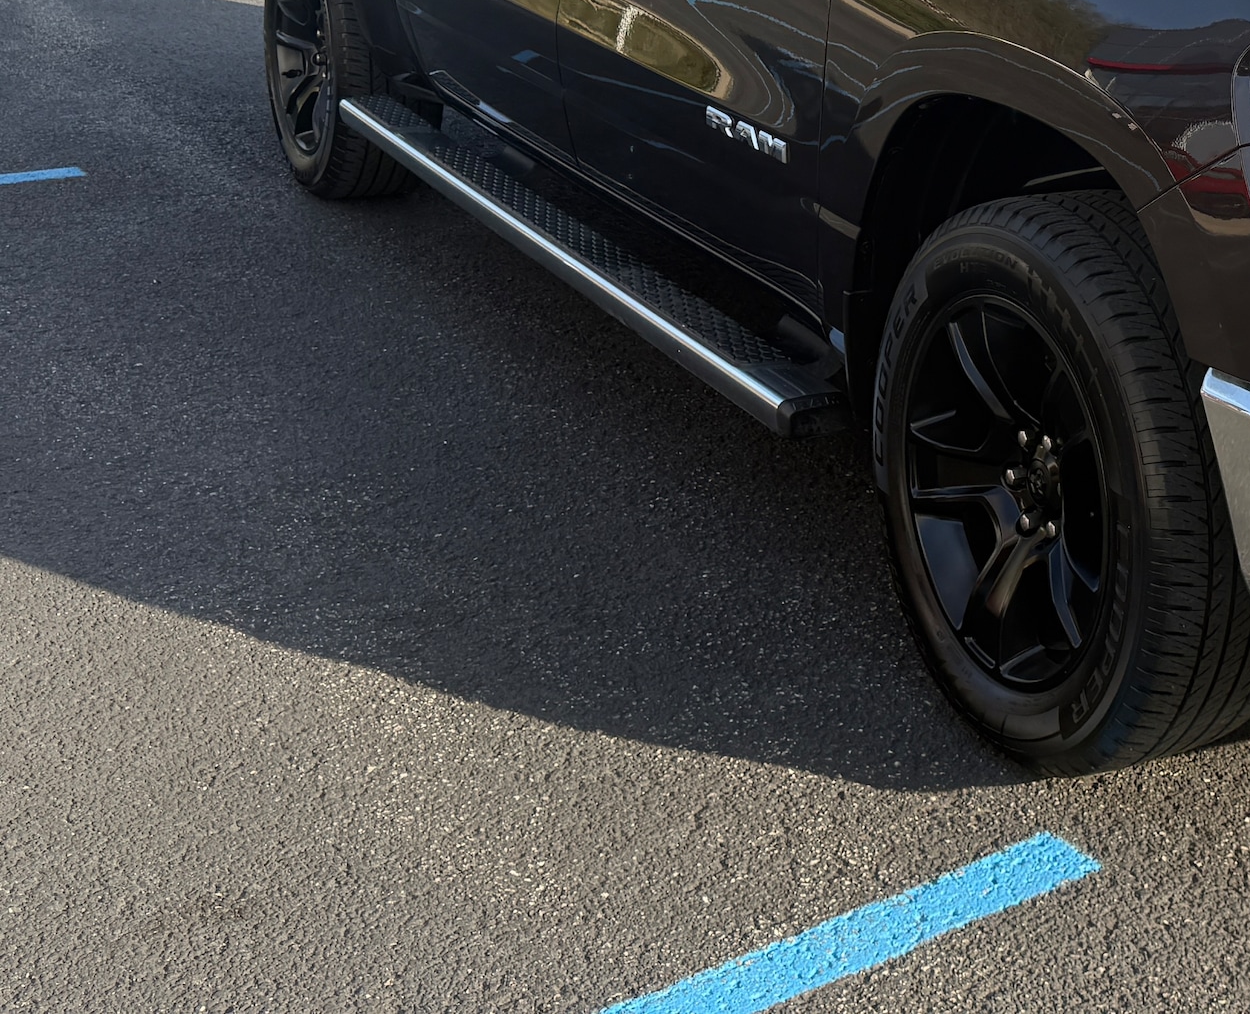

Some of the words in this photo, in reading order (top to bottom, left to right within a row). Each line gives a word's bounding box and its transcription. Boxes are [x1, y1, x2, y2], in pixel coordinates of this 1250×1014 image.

[706, 105, 788, 164] RAM
[874, 283, 919, 468] COOPER
[1071, 520, 1131, 725] COOPER
